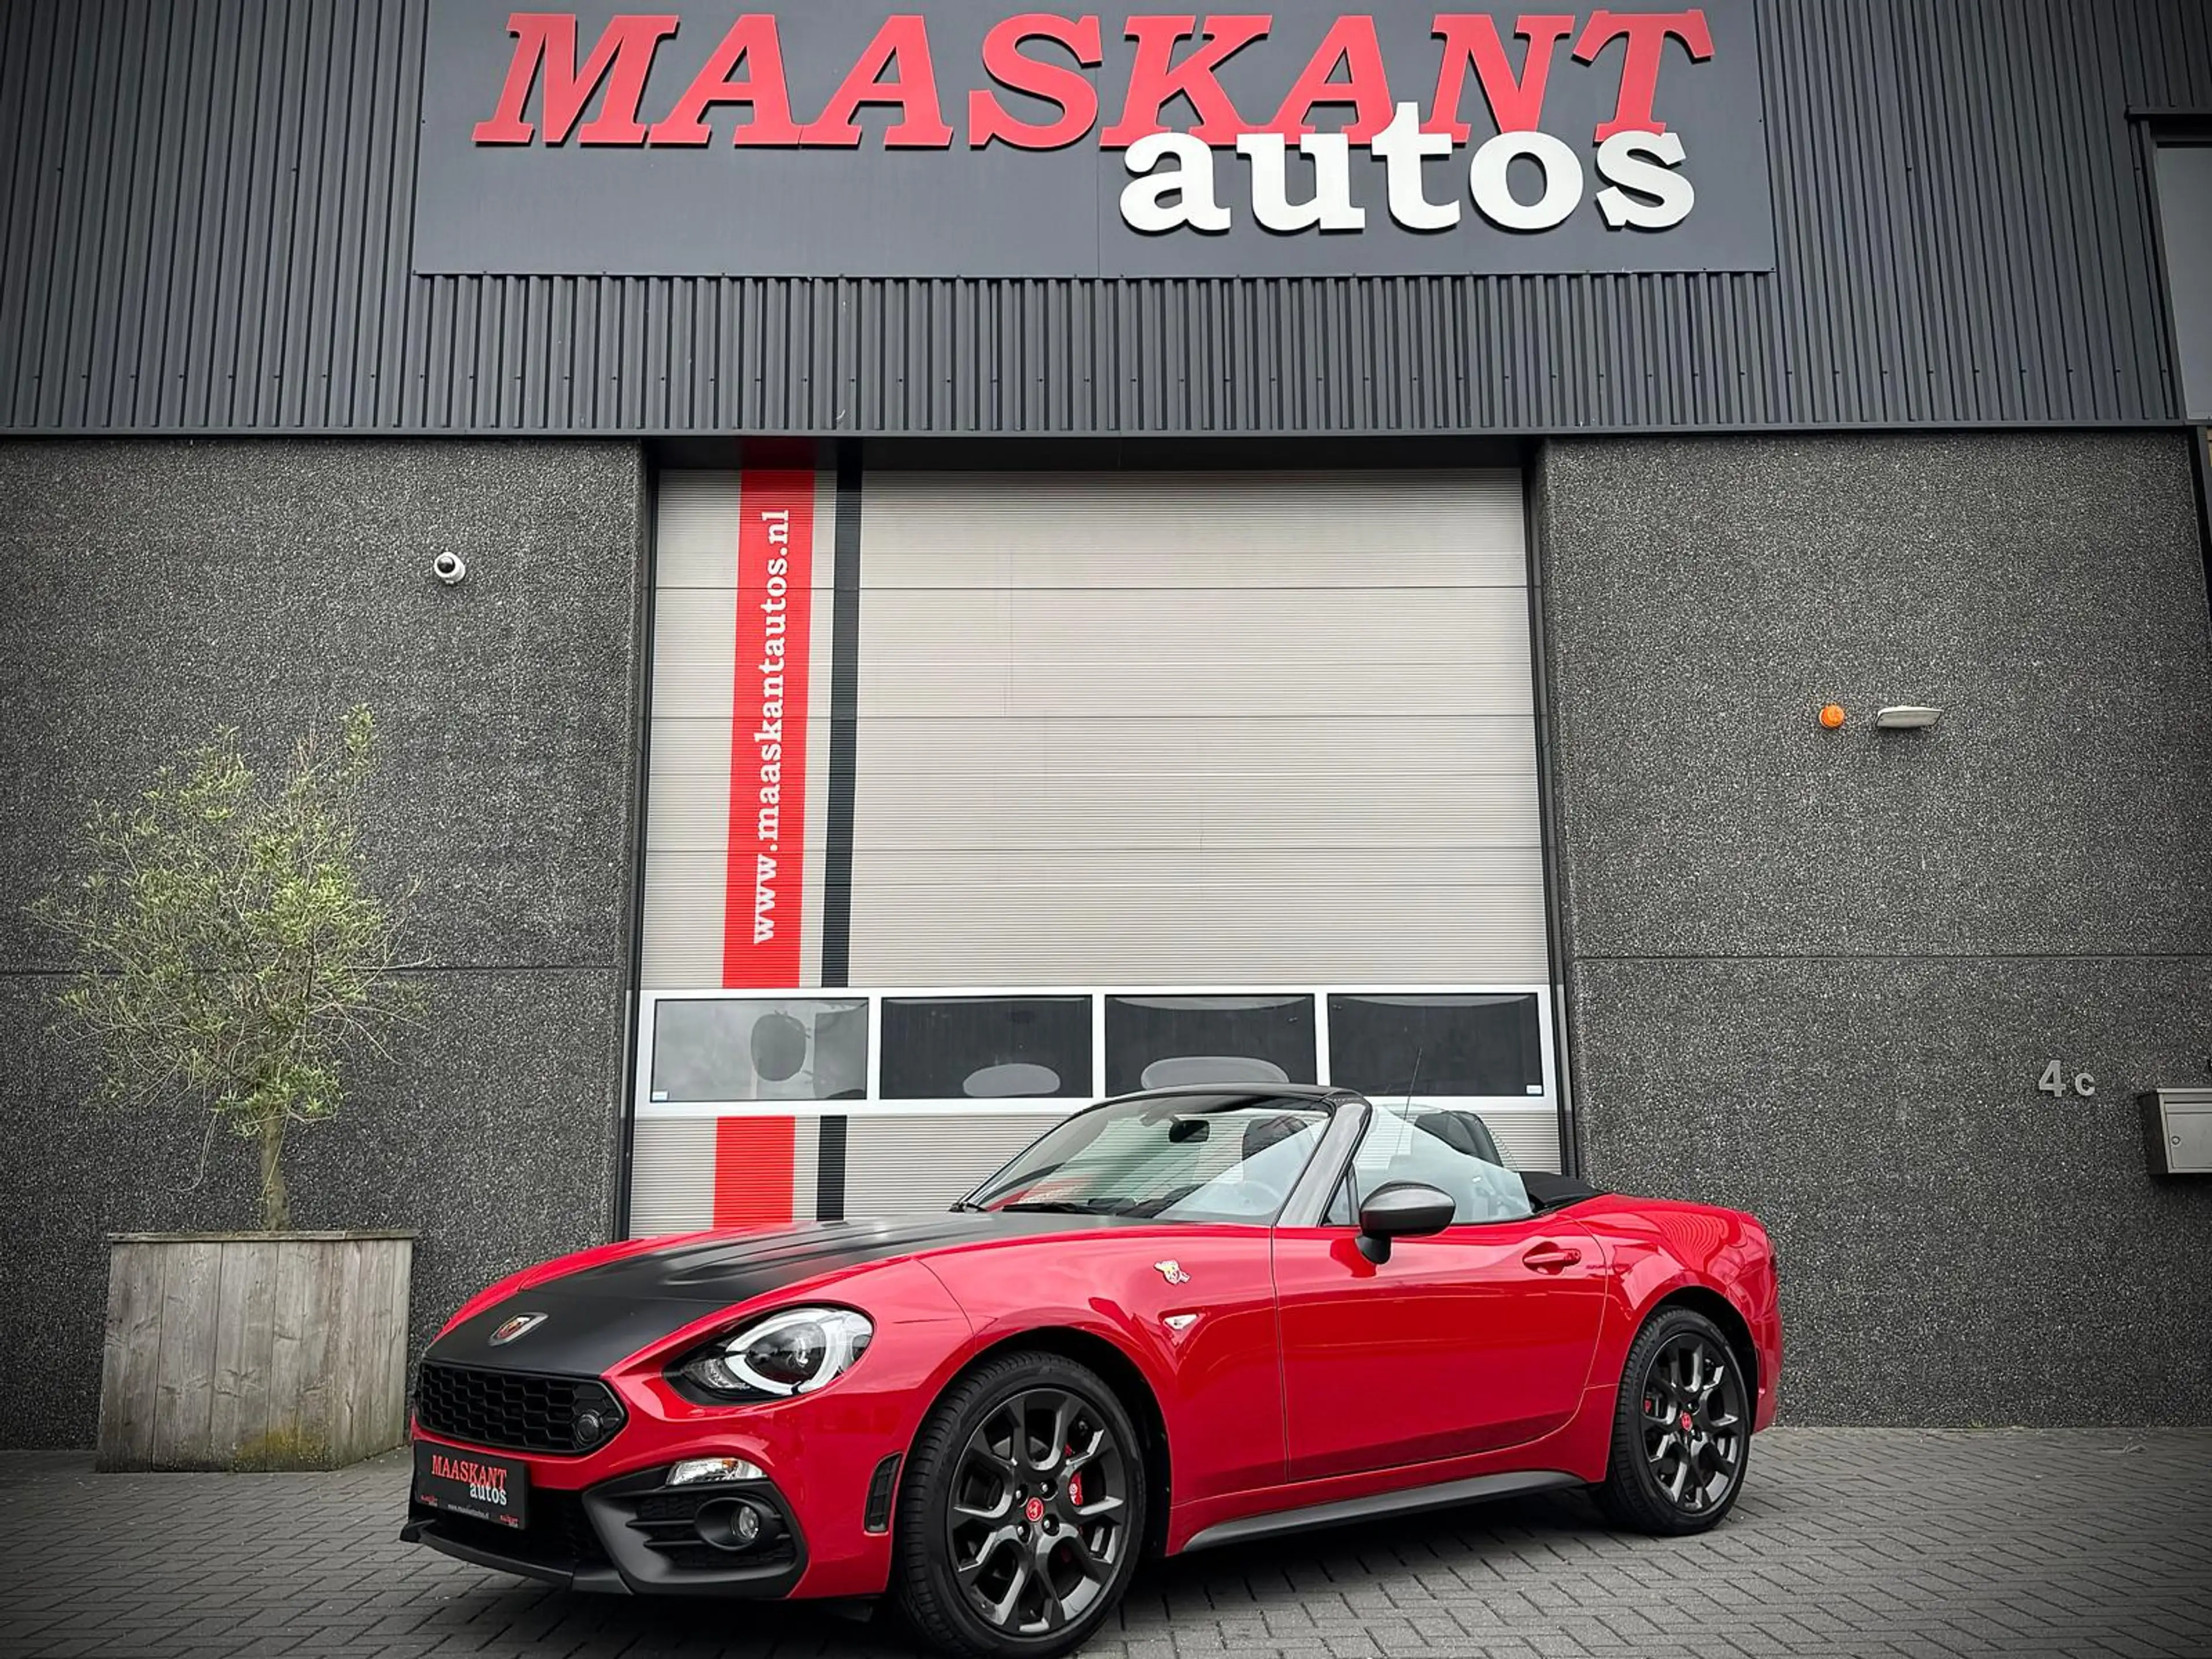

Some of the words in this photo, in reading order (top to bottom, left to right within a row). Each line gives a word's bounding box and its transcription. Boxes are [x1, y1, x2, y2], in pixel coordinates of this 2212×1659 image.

[472, 10, 1714, 148] MAASKANT
[1120, 102, 1695, 233] autos
[752, 509, 789, 945] www.maaskantautos.nl
[431, 1454, 507, 1490] MAASKANT
[469, 1482, 507, 1506] autos
